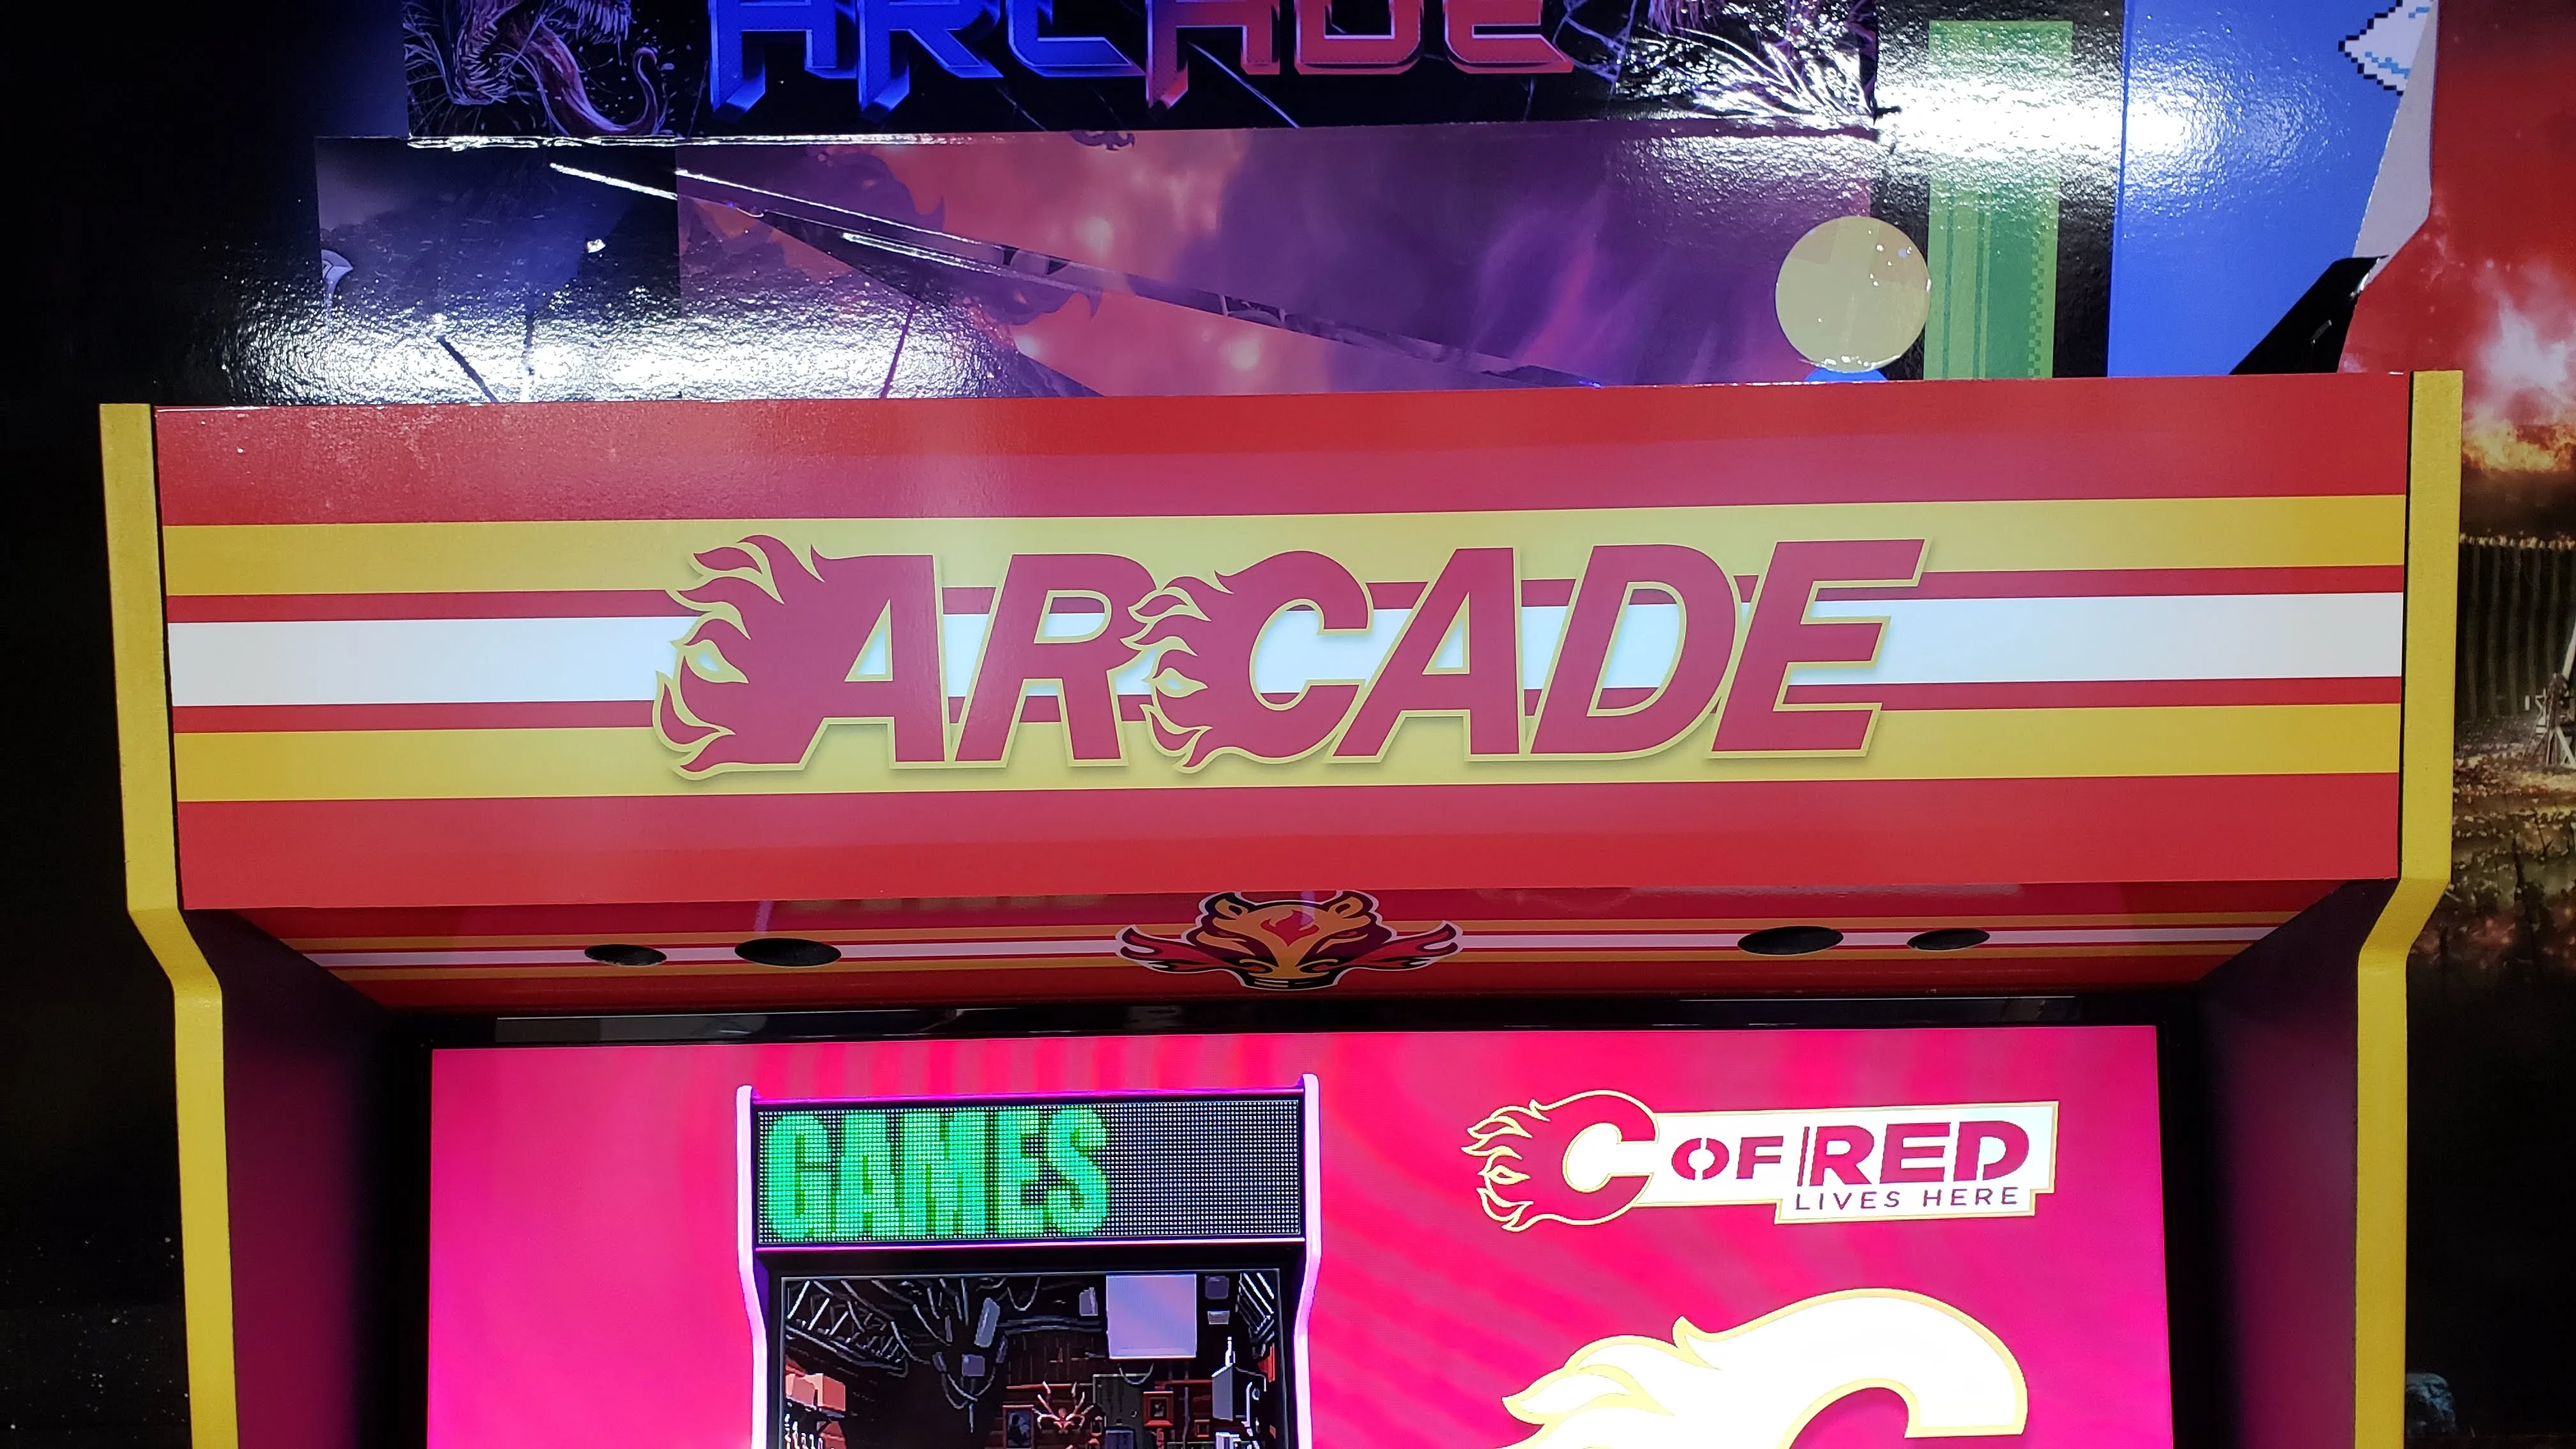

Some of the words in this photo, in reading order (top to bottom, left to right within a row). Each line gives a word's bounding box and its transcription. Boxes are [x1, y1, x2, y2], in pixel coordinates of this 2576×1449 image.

[709, 0, 1574, 121] ARCADE
[654, 532, 1932, 781] ARCADE
[767, 1105, 1112, 1238] GAMES
[1671, 1135, 1784, 1181] OF
[1795, 1190, 1901, 1211] LIVES
[1922, 1186, 2019, 1208] HERE
